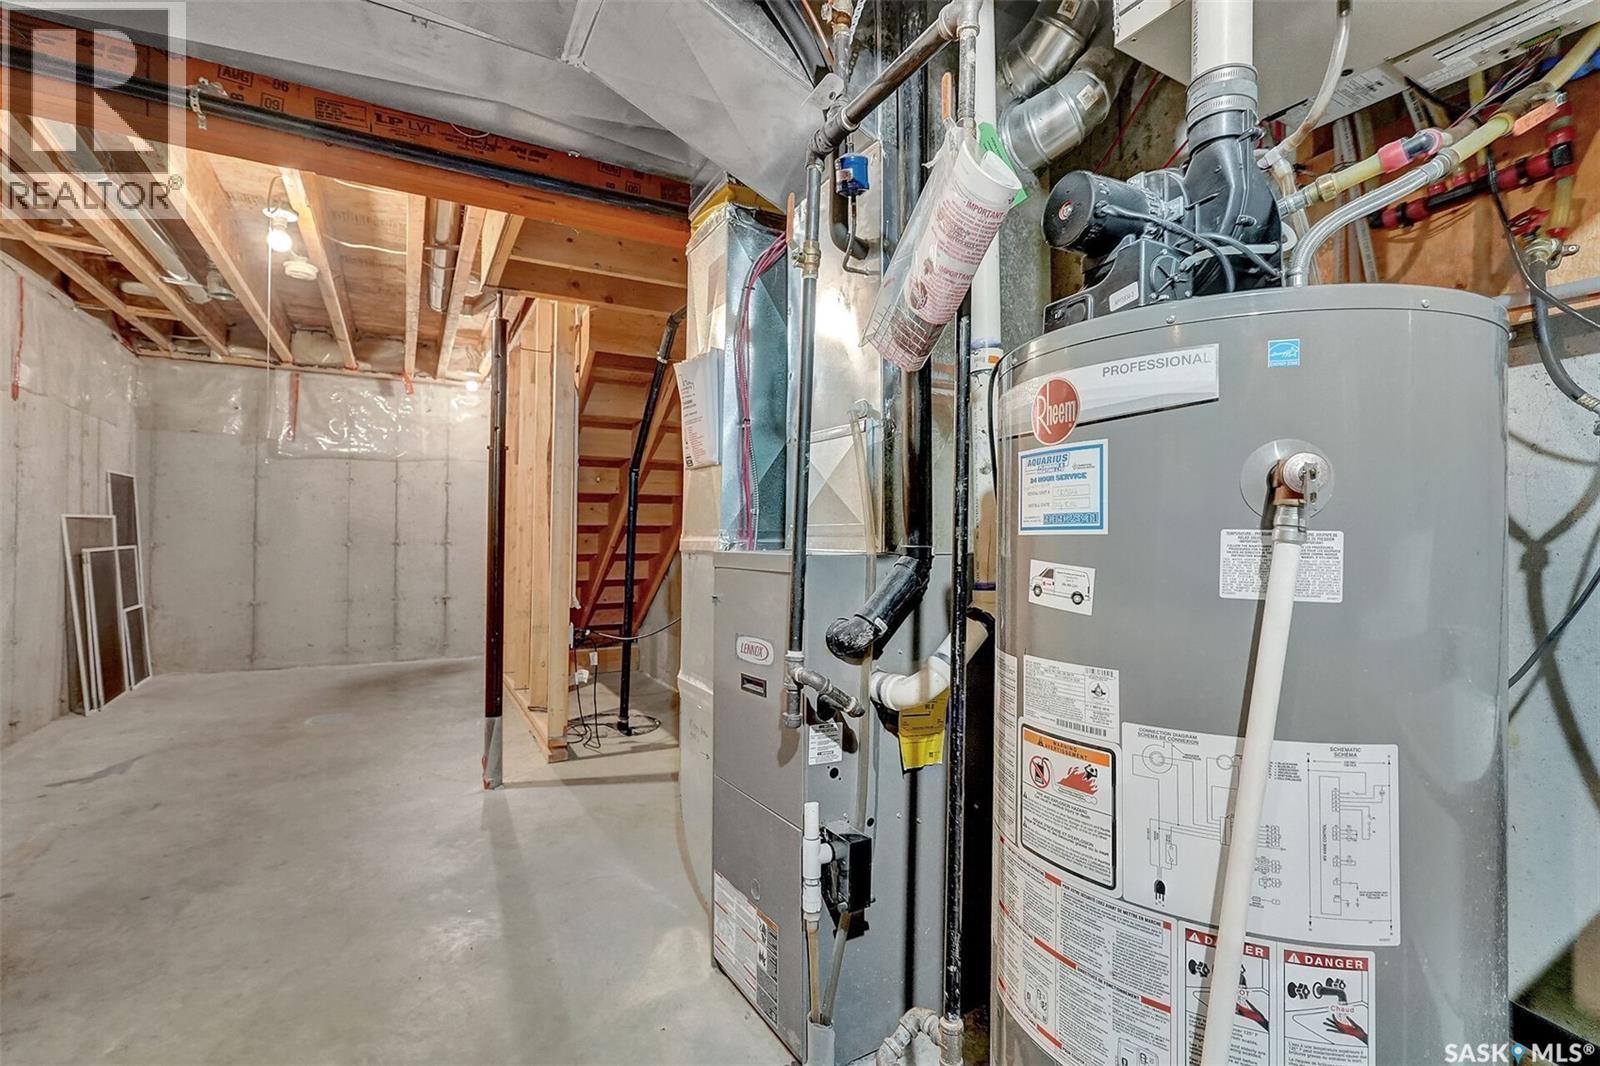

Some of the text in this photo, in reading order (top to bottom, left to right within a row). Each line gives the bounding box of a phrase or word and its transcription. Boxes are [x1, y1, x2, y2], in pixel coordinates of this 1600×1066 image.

[220, 64, 250, 84] AUG
[264, 96, 280, 111] 09
[408, 118, 434, 135] LVL
[966, 200, 1004, 219] IMPORTANT
[937, 264, 975, 282] IMPORTANT
[1102, 352, 1212, 377] PROFESSIONAL
[1036, 380, 1076, 435] Rheem
[1027, 453, 1069, 467] AQUARIUS
[1038, 475, 1055, 484] HOUR
[1055, 471, 1087, 481] SERVICE
[740, 642, 763, 658] LENNOX
[1138, 728, 1198, 740] CONNECTION DIAGRAM
[1167, 737, 1199, 745] CONNEXION
[1044, 743, 1088, 761] AVERTISSEMENT
[1304, 955, 1364, 969] DANGER
[1330, 1005, 1355, 1013] Chaud
